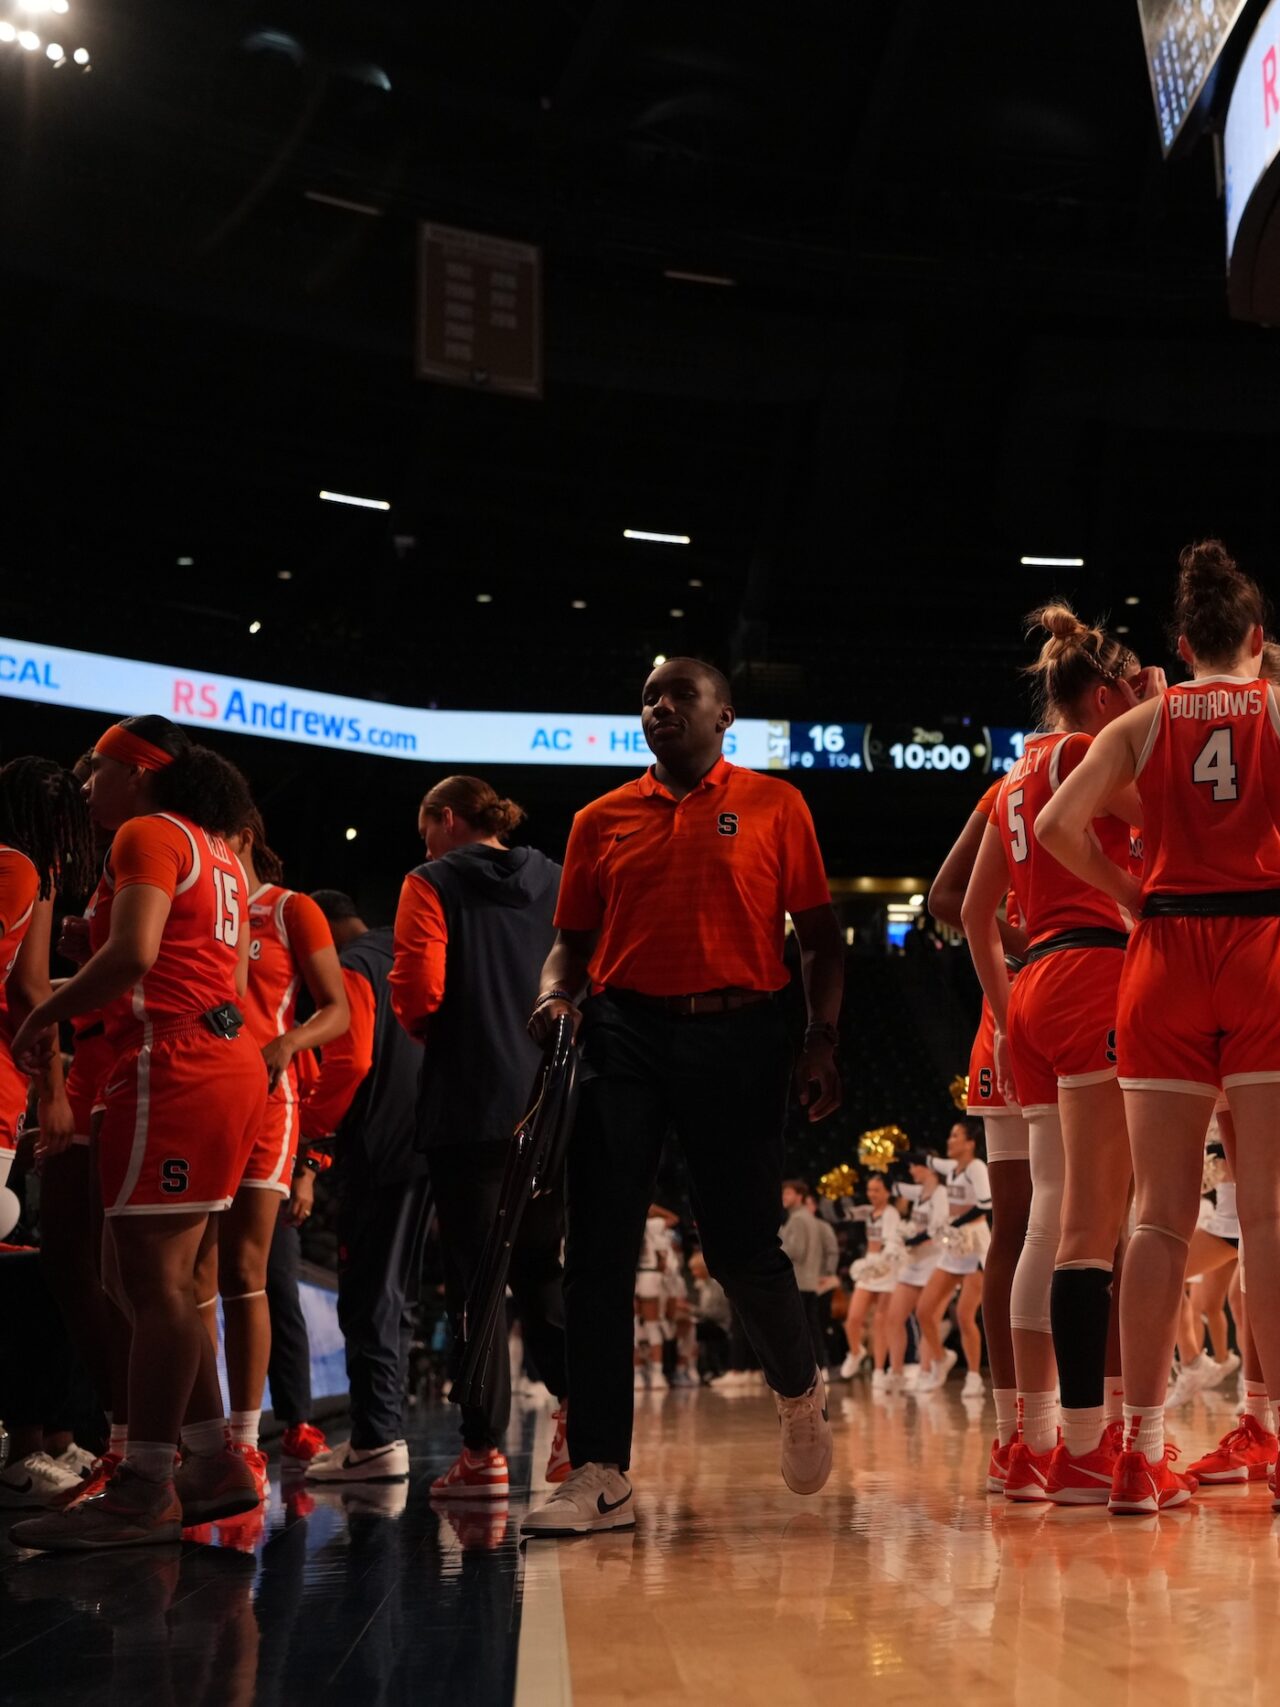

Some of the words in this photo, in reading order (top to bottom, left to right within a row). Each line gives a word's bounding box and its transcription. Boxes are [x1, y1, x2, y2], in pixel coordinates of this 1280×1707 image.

[1168, 688, 1262, 721] BURROWS
[530, 728, 573, 751] AC
[808, 723, 845, 752] 16
[889, 742, 970, 770] 10:00
[1191, 724, 1239, 802] 4
[717, 811, 739, 837] S
[1007, 788, 1029, 863] 5
[212, 865, 240, 948] 15
[978, 1067, 994, 1099] S
[159, 1157, 191, 1196] S
